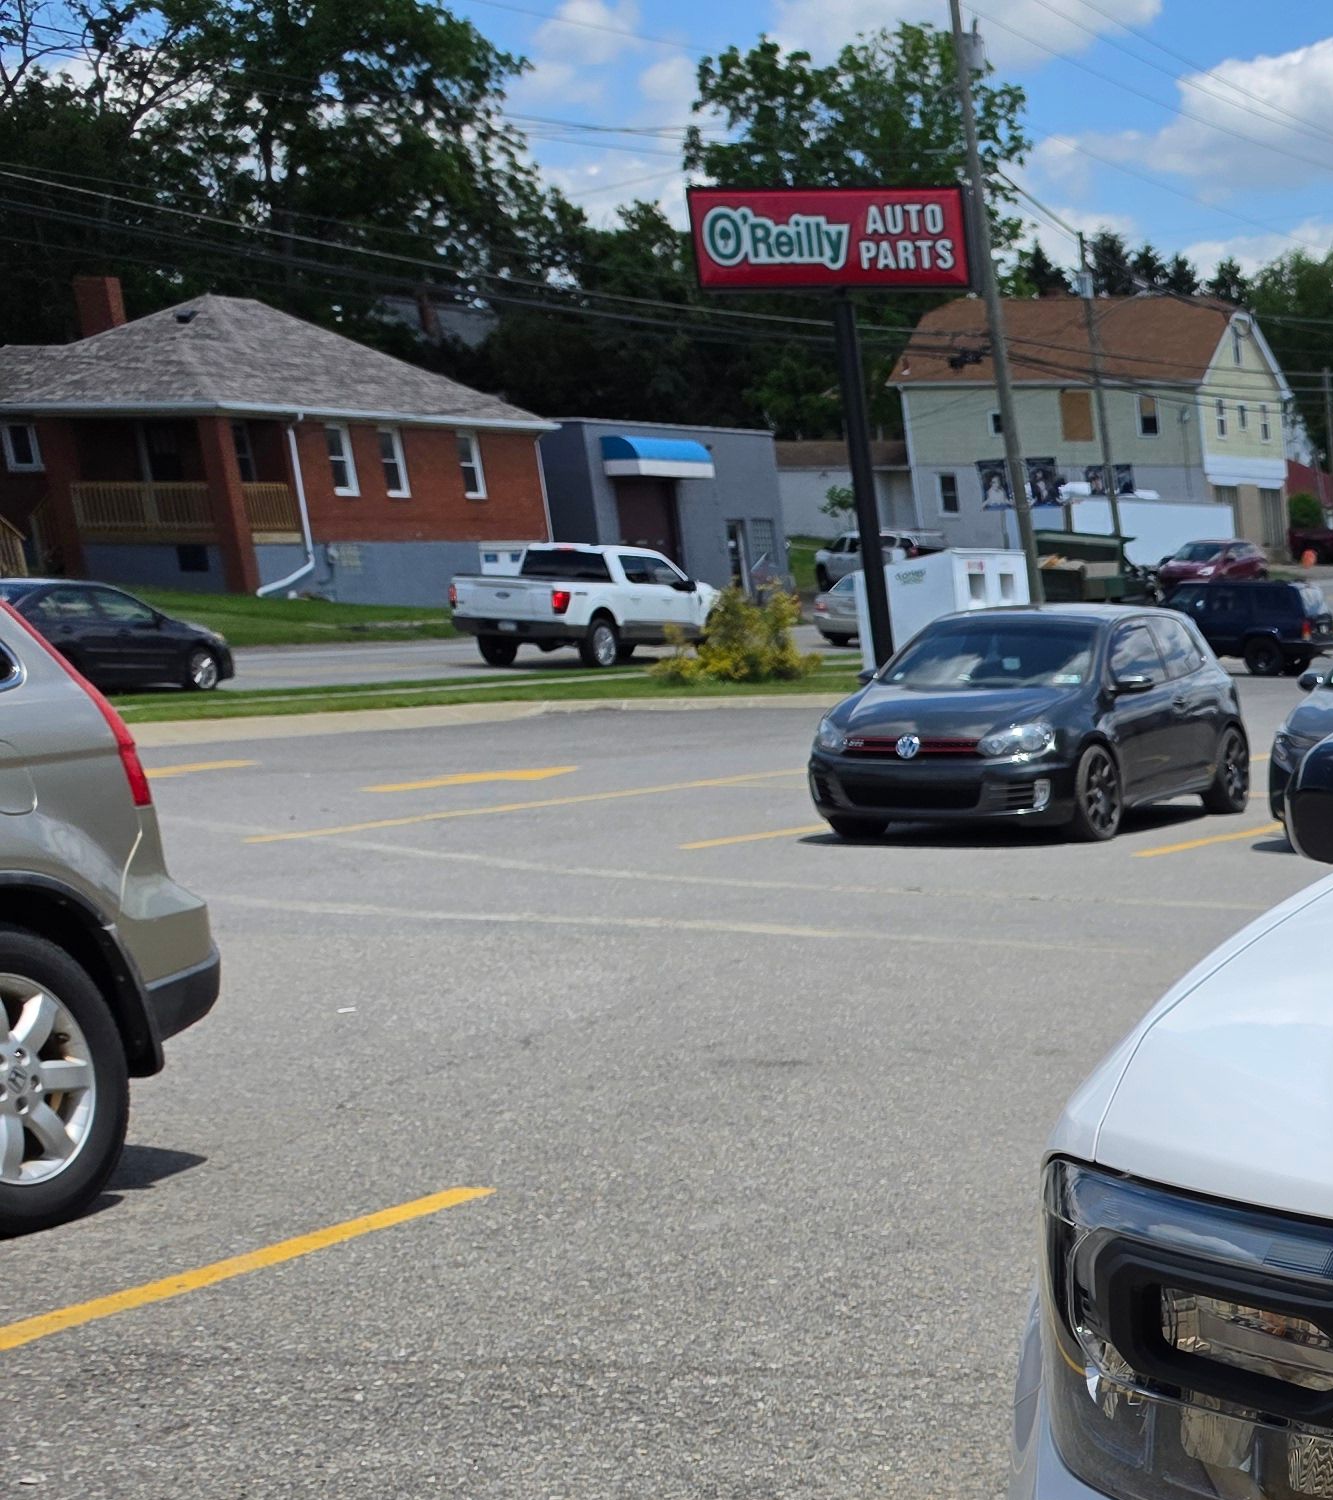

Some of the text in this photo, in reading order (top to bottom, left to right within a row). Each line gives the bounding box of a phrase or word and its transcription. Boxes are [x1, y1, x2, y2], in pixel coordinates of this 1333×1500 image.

[865, 203, 945, 236] AUTO
[705, 208, 847, 268] O'Reilly
[858, 238, 954, 271] PARTS
